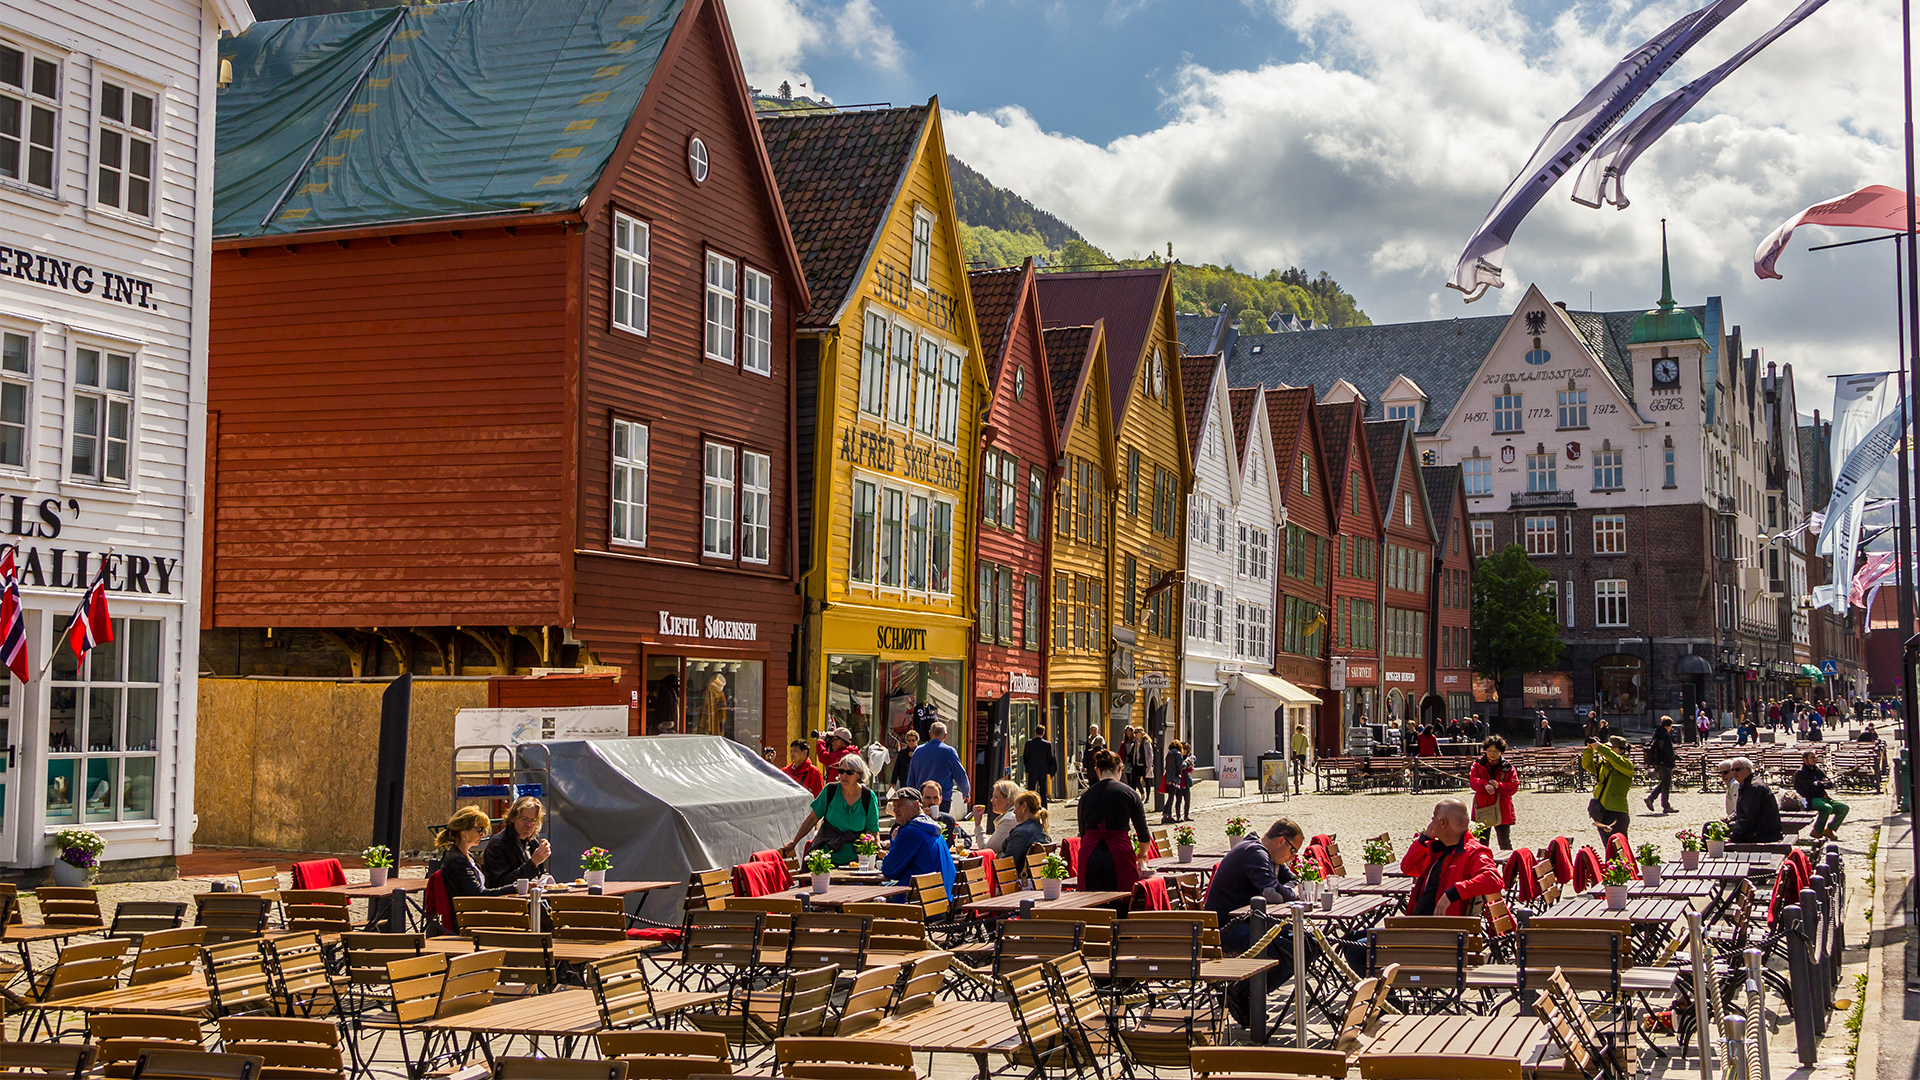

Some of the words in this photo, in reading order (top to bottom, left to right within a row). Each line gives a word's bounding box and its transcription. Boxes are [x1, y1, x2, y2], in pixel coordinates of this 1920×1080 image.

[0, 246, 94, 294] ERING
[102, 271, 158, 311] INT.
[873, 259, 909, 311] SILD
[926, 288, 960, 335] FISK
[1527, 408, 1553, 419] 1712.
[1592, 404, 1618, 415] 1912.
[840, 425, 895, 473] ALFRED
[903, 443, 962, 490] SKULSTAD
[877, 626, 927, 651] SCHJØTT
